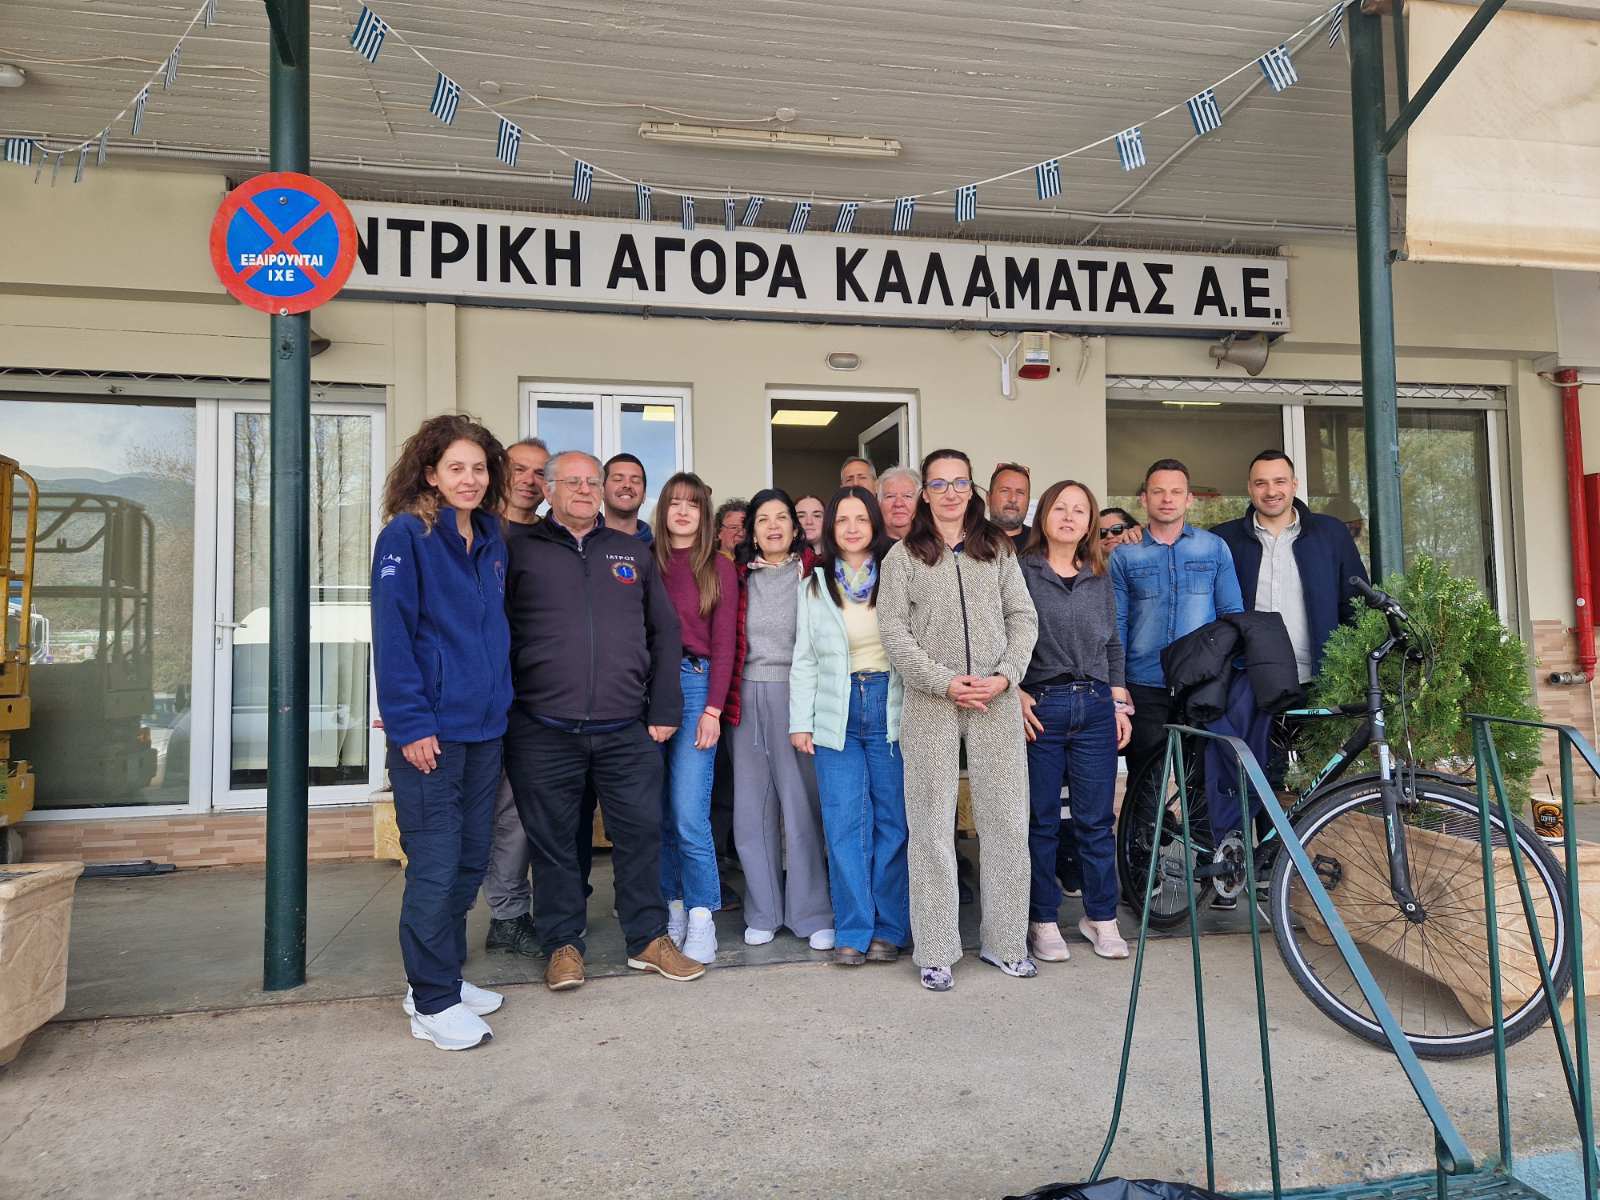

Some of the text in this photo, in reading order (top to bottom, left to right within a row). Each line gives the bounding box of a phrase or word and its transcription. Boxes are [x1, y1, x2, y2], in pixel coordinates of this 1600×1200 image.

[240, 254, 324, 266] ΕΞΑΙΡΟΥΝΤΑΙ
[355, 216, 1282, 319] ΝΤΡΙΚΗ ΑΓΟΡΑ ΚΑΛΑΜΑΤΑΣ Α.Ε.
[268, 269, 295, 281] ΙΧΕ
